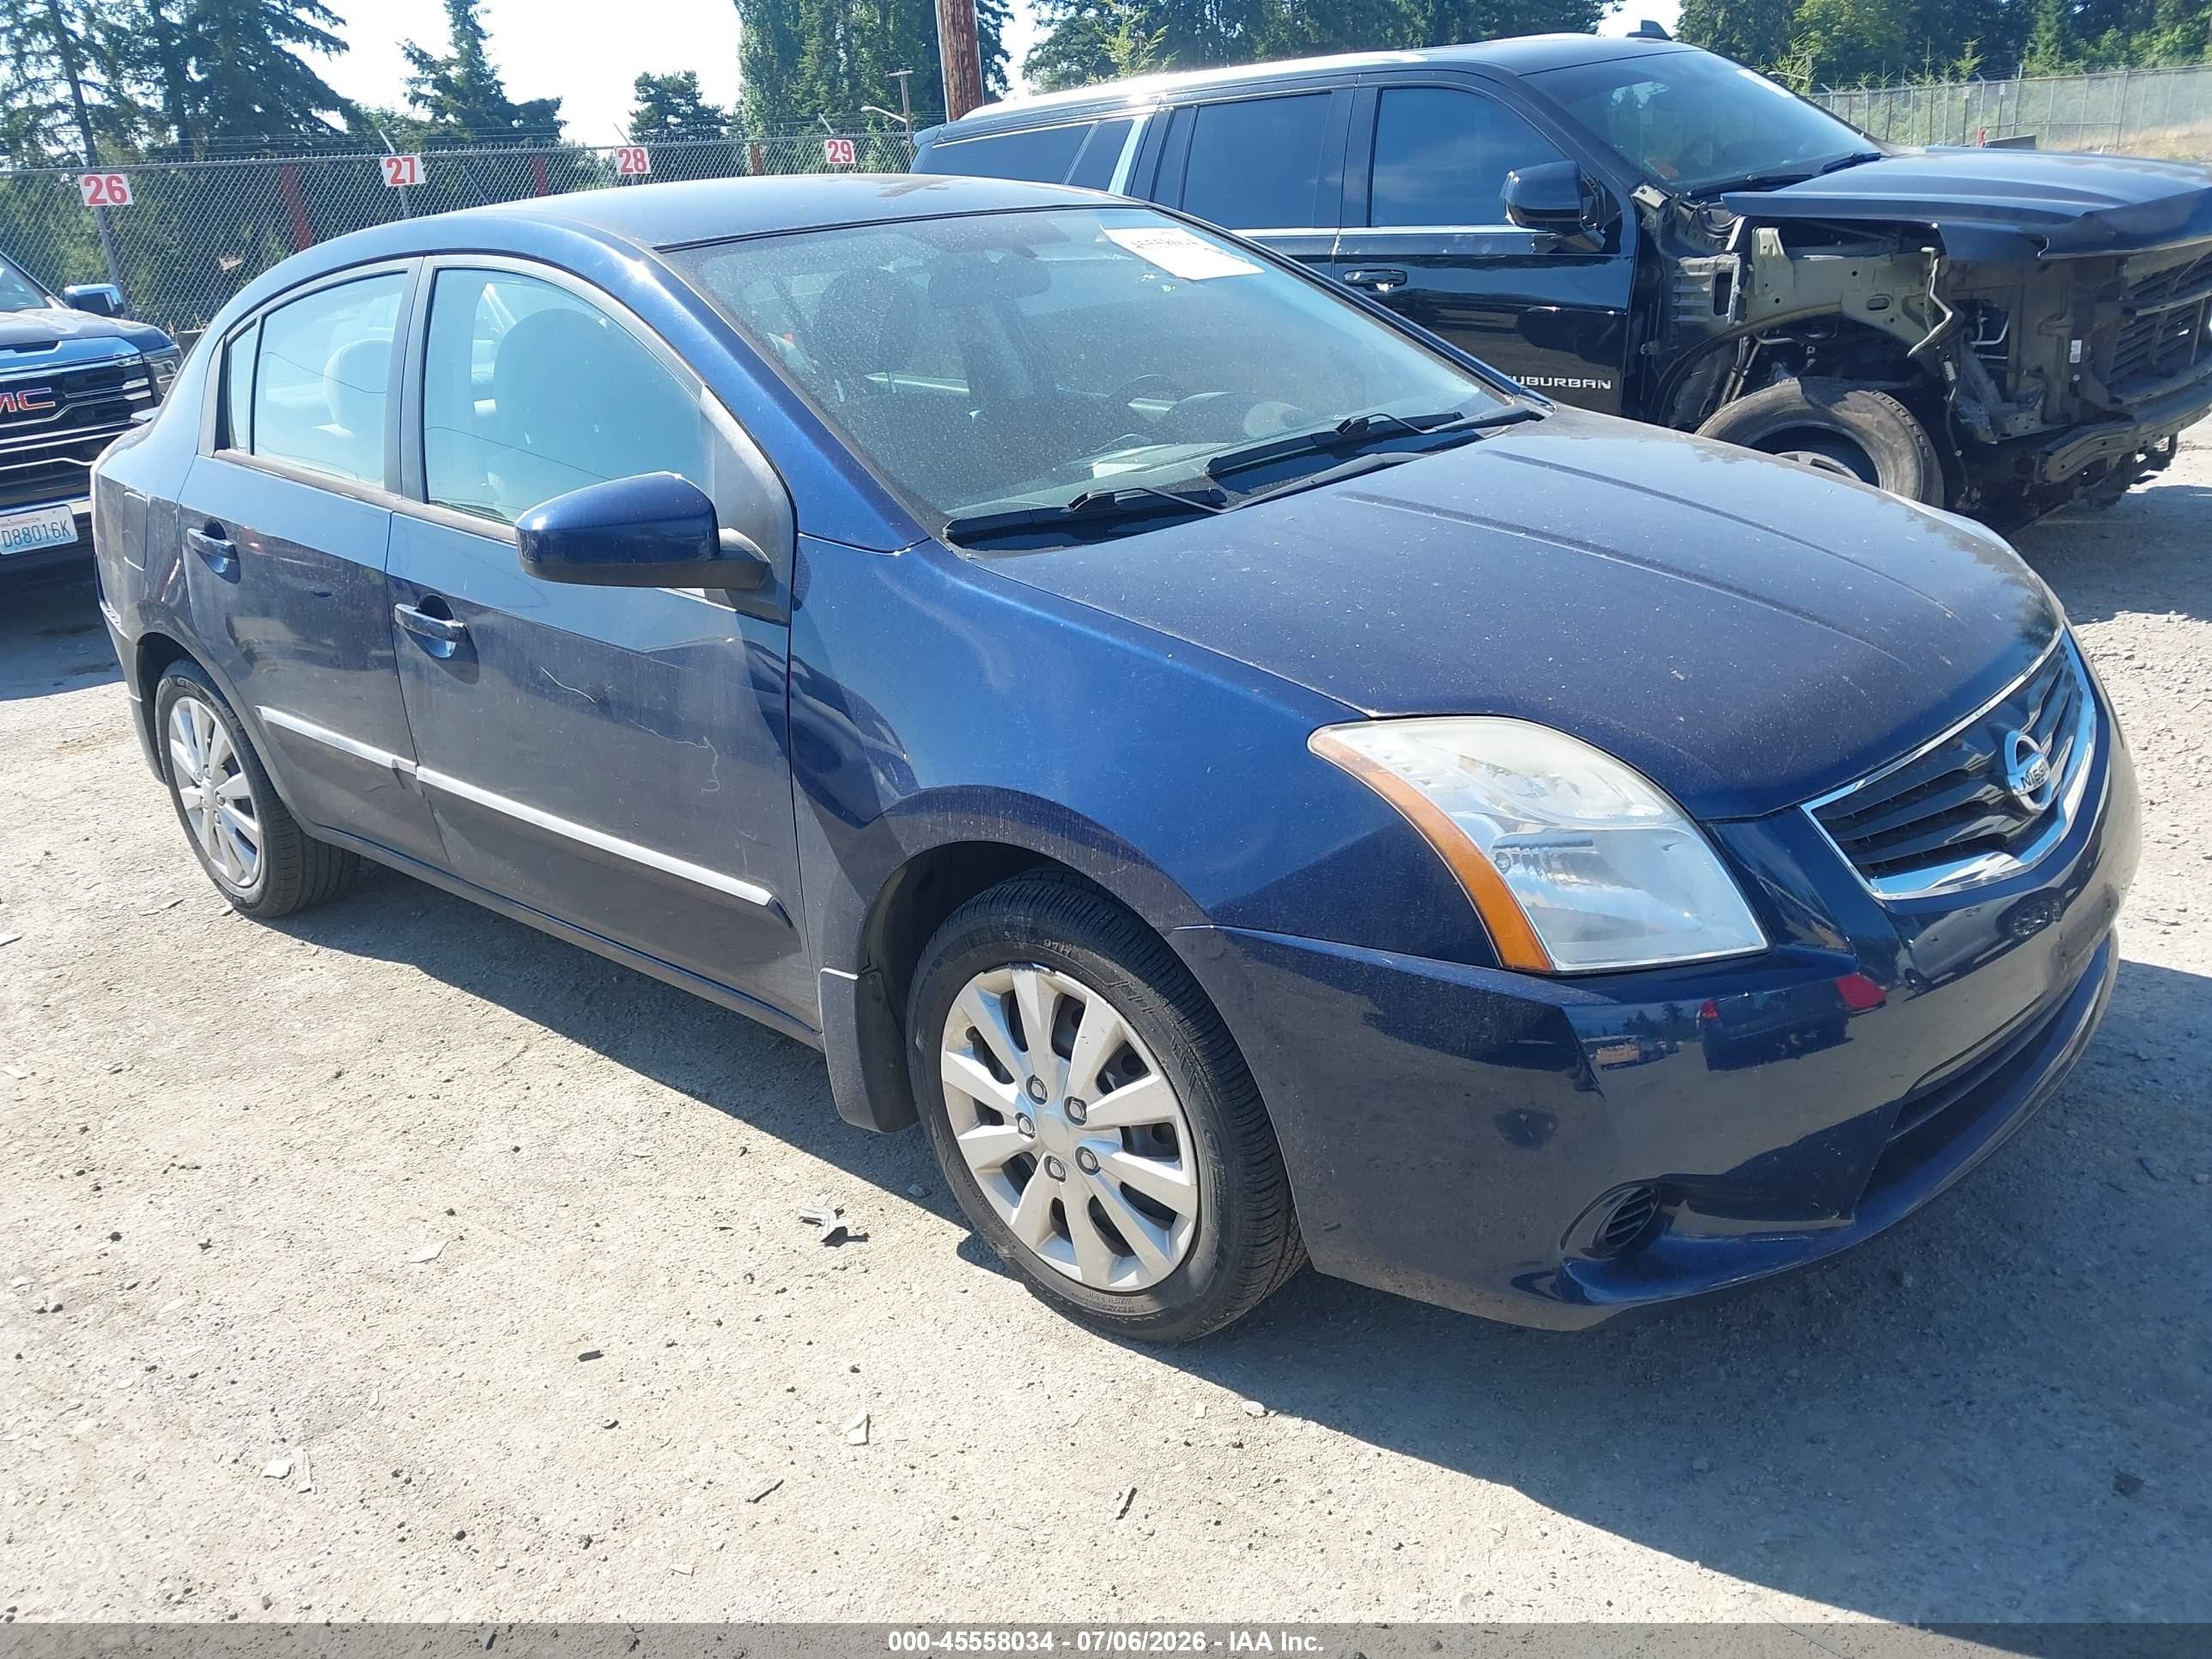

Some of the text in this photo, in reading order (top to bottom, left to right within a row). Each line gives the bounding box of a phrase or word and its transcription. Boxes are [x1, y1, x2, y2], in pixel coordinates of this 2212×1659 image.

[618, 148, 647, 173] 28
[828, 140, 853, 162] 29
[386, 157, 415, 185] 27
[84, 175, 127, 204] 26
[1509, 375, 1612, 390] UBURBAN
[0, 387, 56, 412] MC
[2, 520, 70, 548] D88016K
